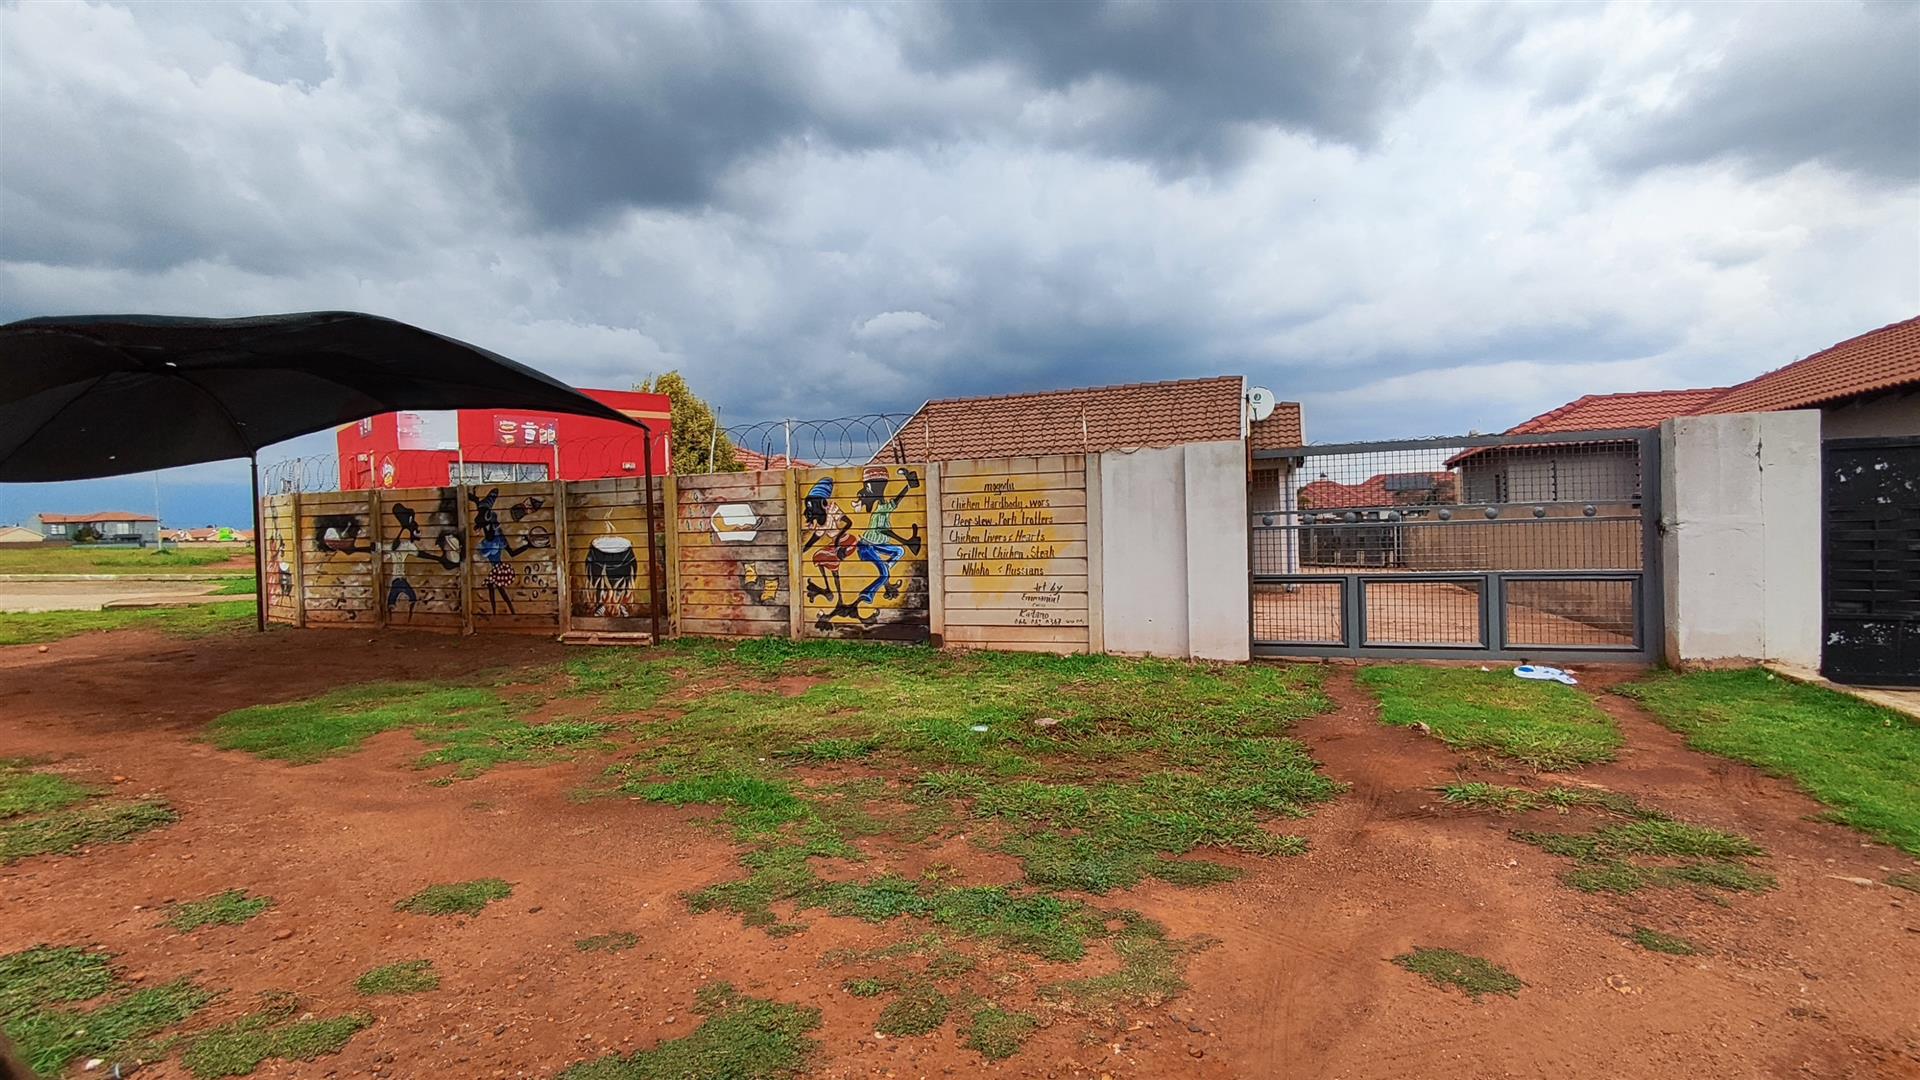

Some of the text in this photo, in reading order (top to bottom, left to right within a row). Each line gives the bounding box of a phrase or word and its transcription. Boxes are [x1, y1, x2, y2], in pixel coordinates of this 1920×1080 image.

[949, 529, 980, 543] Chicken
[1015, 528, 1045, 542] Hearts
[956, 545, 987, 559] Grilled
[1030, 543, 1055, 558] Steak
[1005, 560, 1044, 575] Russians
[1050, 581, 1064, 594] by
